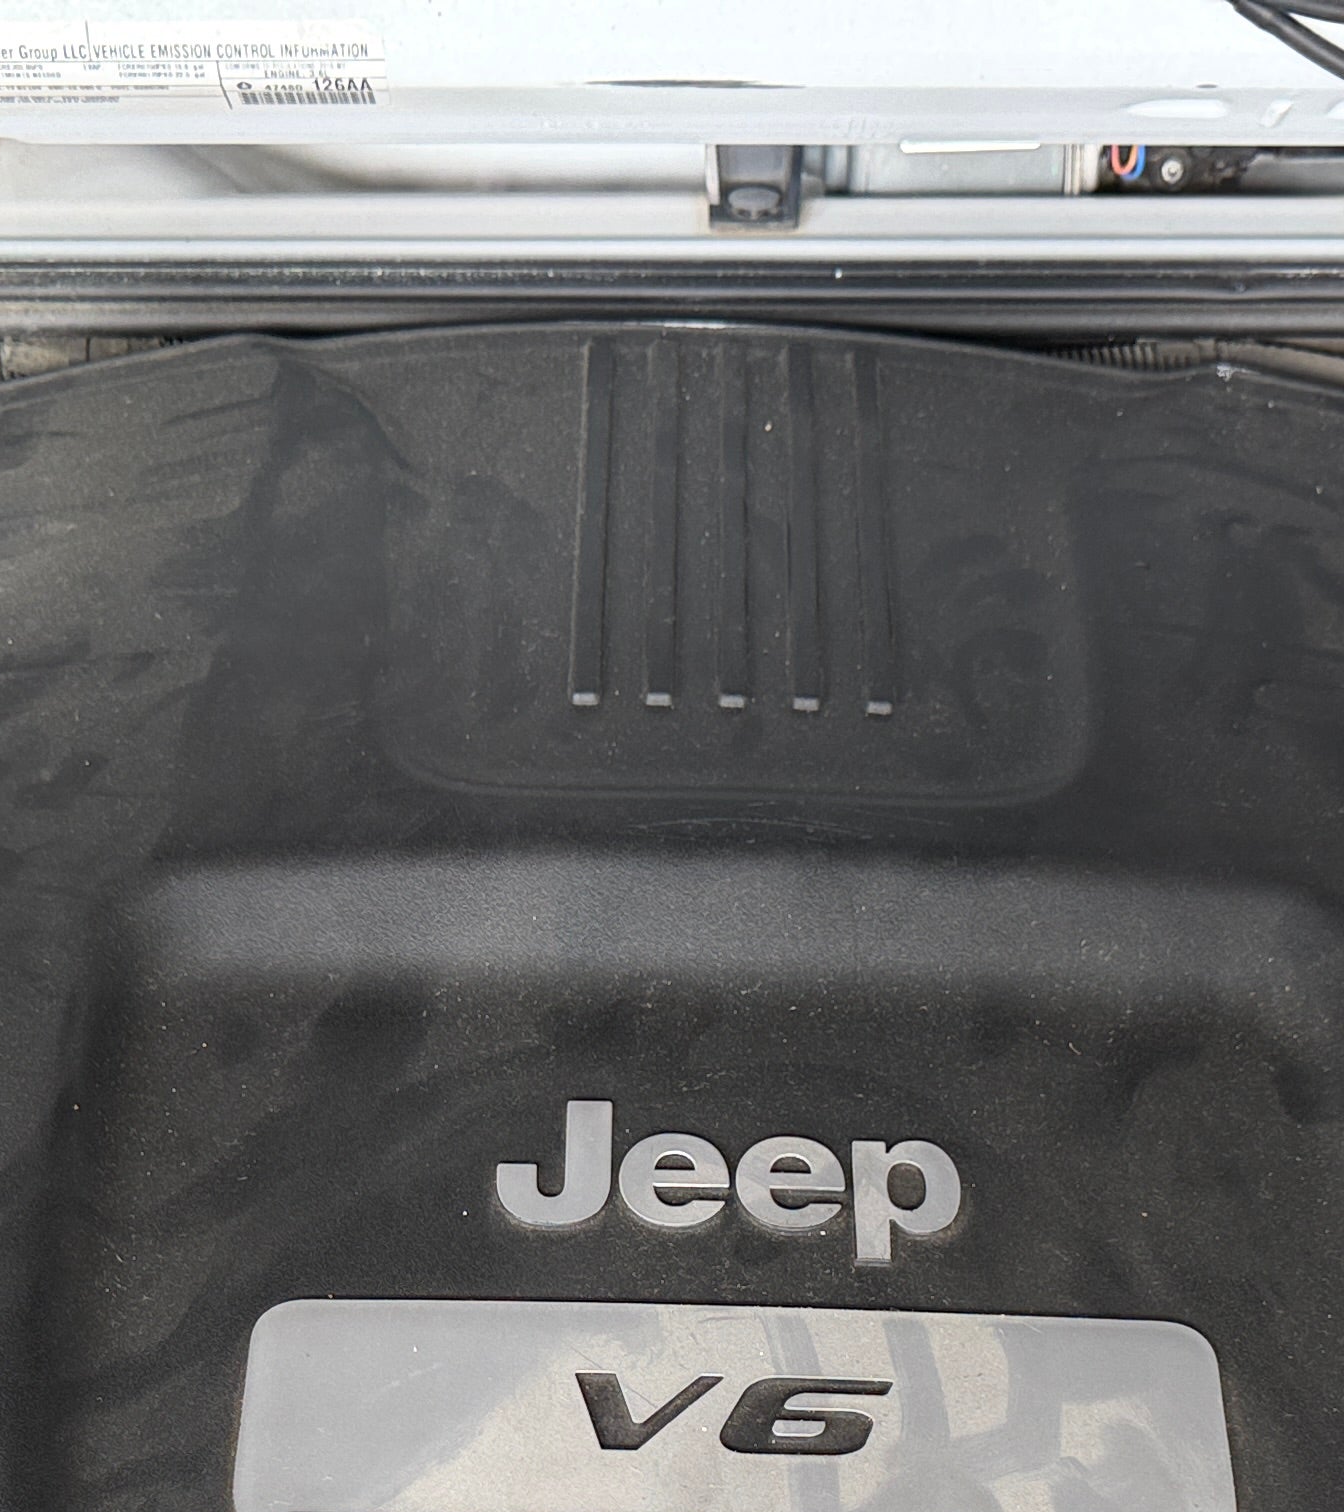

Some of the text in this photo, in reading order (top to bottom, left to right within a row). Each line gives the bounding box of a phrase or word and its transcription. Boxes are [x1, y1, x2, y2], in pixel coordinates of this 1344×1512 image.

[18, 44, 57, 62] Group
[62, 44, 87, 60] LLC
[93, 44, 145, 60] VEHICLE
[150, 44, 212, 59] EMISSION
[216, 43, 275, 59] CONTROL
[496, 1099, 962, 1264] Jeep
[574, 1371, 893, 1457] V6
